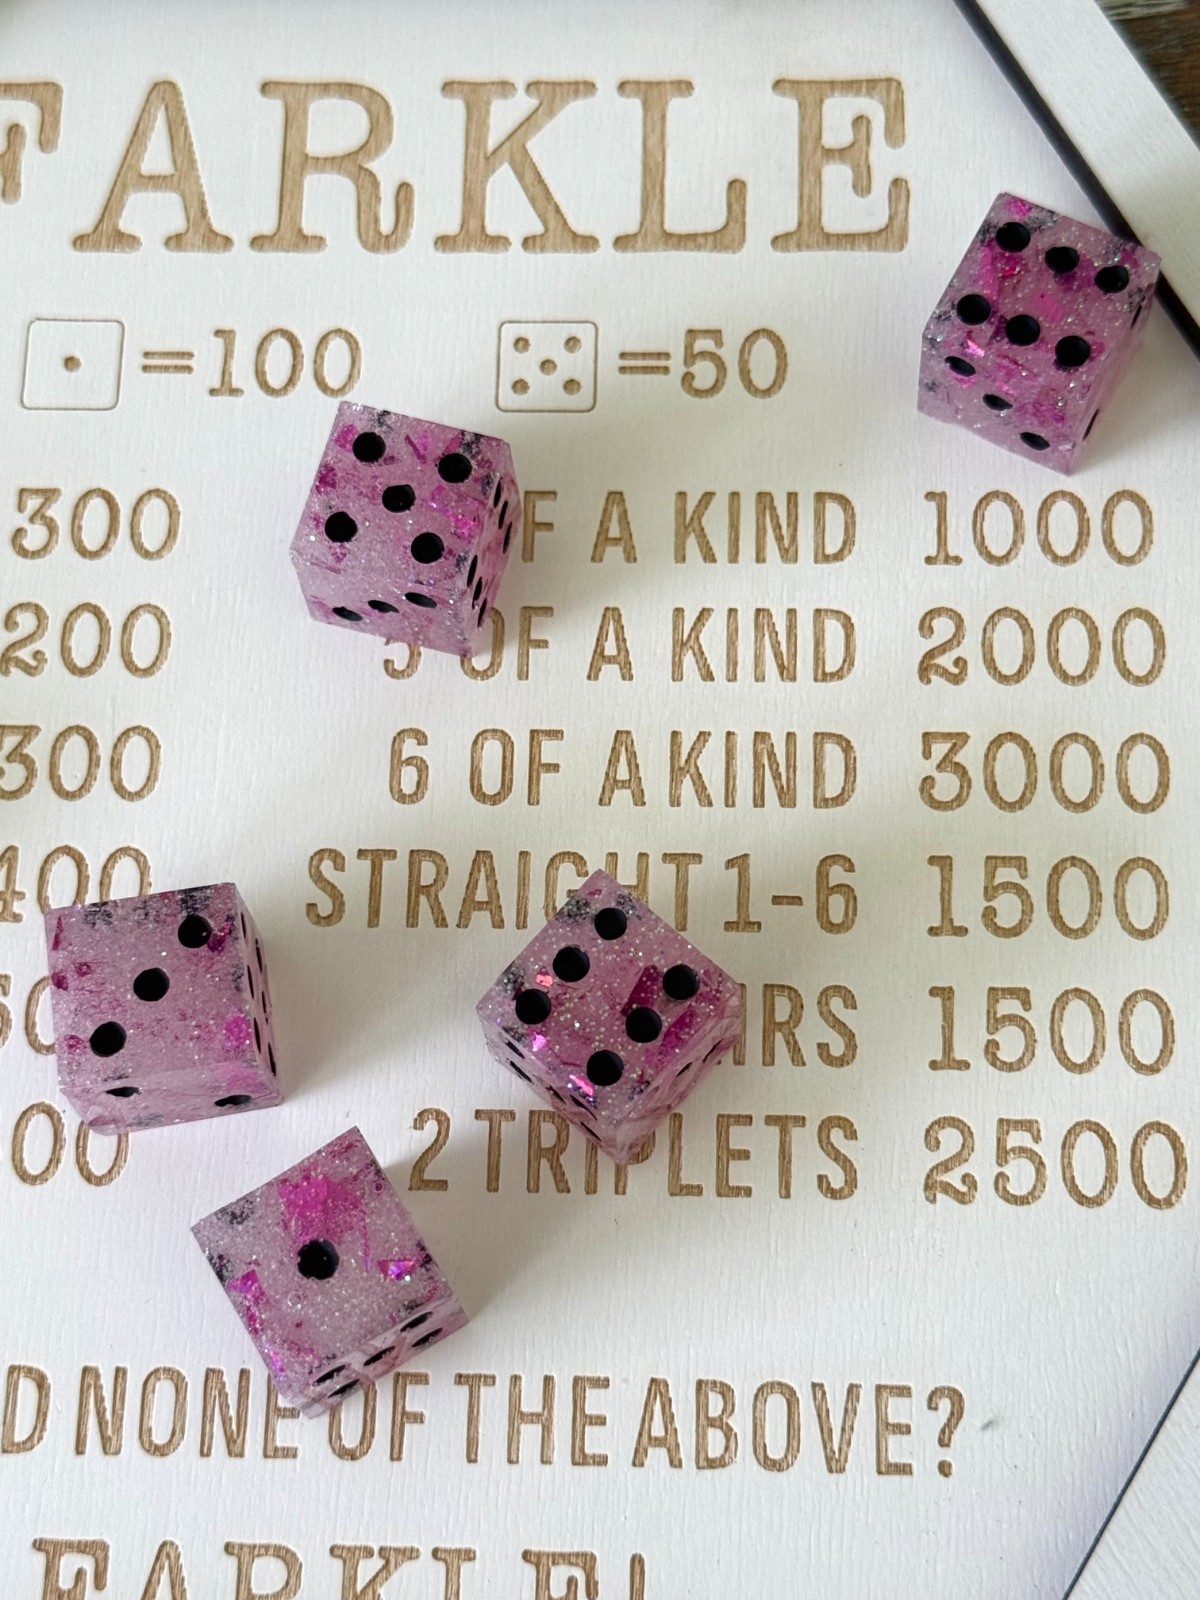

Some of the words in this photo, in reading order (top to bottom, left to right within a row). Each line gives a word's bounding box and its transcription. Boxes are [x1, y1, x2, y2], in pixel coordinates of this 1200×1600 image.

[11, 486, 180, 559] 300
[519, 487, 559, 565] F
[590, 487, 639, 565] A
[673, 489, 857, 564] KIND
[926, 488, 1154, 565] 1000
[0, 601, 171, 677] 200
[461, 602, 557, 680] OF
[587, 605, 634, 681] A
[671, 606, 857, 682] KIND
[917, 605, 1167, 685] 2000
[0, 723, 161, 801] 300
[389, 727, 430, 804] 6
[469, 727, 564, 806] OF
[598, 729, 647, 807] A
[669, 729, 858, 809] KIND
[918, 729, 1172, 813] 3000
[926, 852, 1171, 940] 1500
[928, 984, 1176, 1075] 1500
[408, 1107, 451, 1193] 2
[924, 1115, 1188, 1209] 2500
[75, 1366, 299, 1458] NONE
[329, 1371, 428, 1461] OF
[456, 1373, 609, 1466] THE
[633, 1378, 964, 1477] ABOVE?
